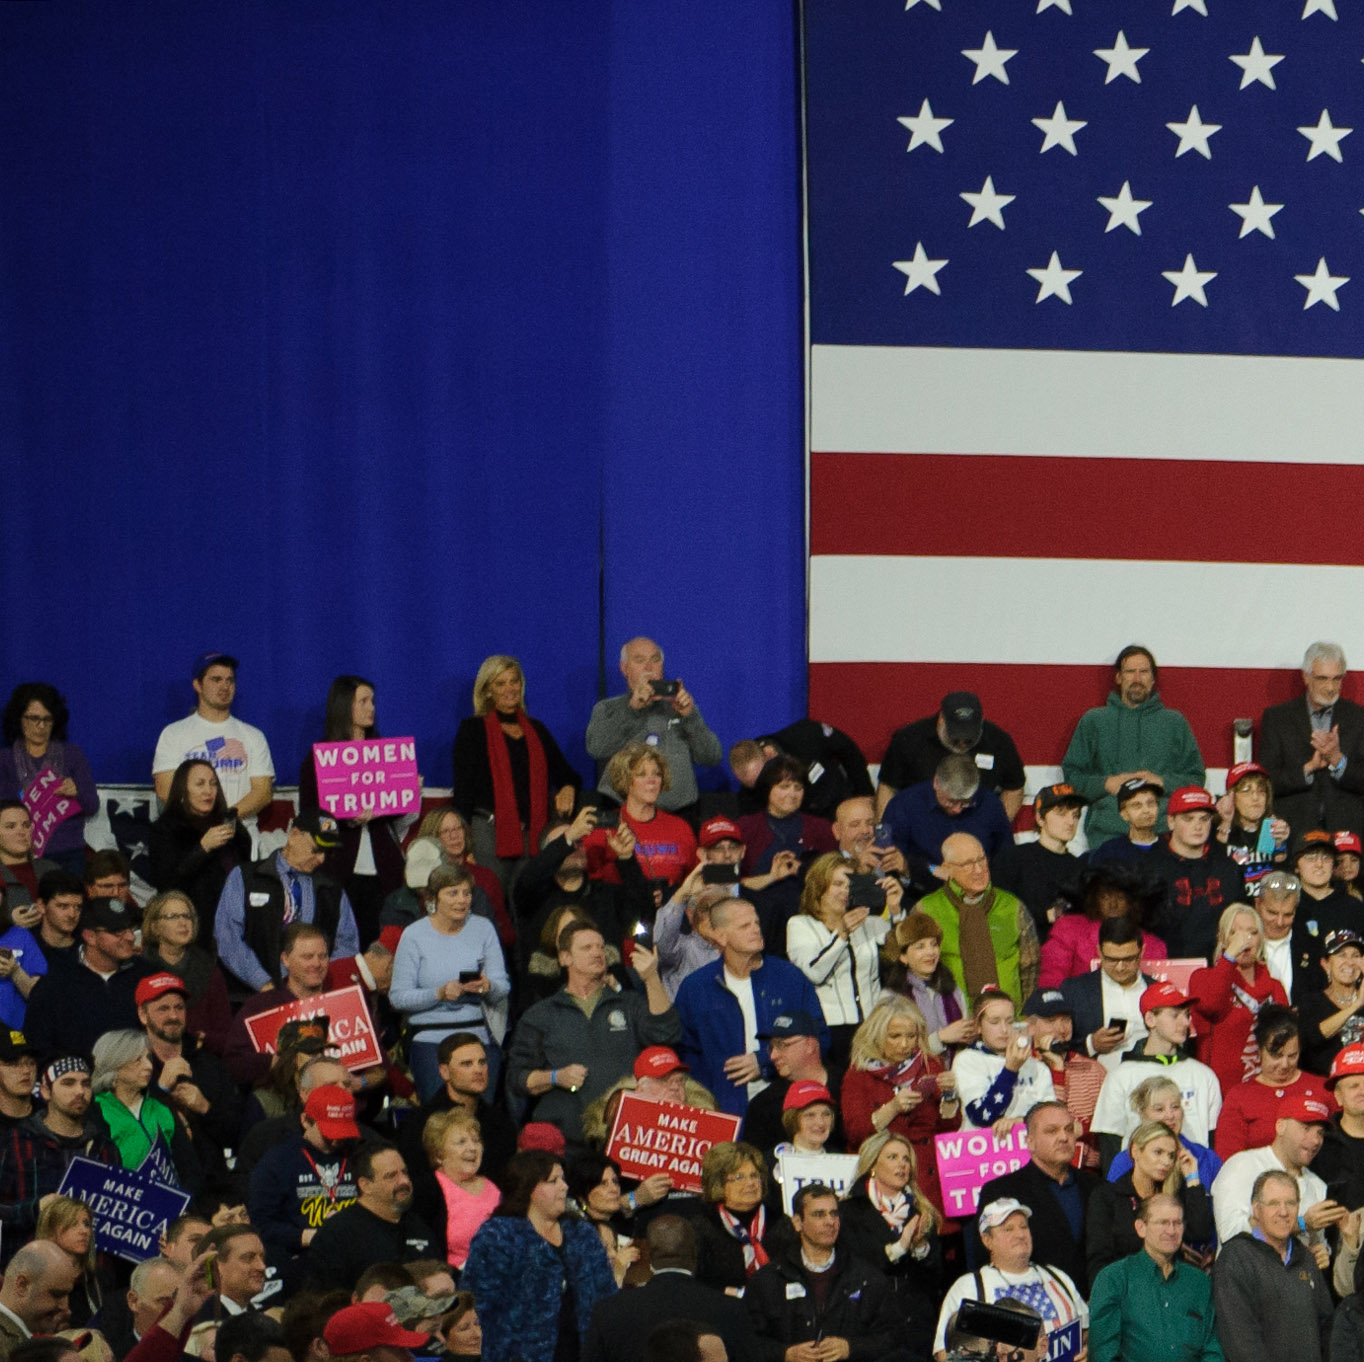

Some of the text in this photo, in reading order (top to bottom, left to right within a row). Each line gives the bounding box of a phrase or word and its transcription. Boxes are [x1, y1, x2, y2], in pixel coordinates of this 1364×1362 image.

[316, 742, 416, 768] WOMEN
[351, 771, 386, 786] FOR
[325, 789, 414, 813] TRUMP
[265, 1016, 370, 1055] AICA
[658, 1113, 698, 1133] MAKE
[614, 1123, 712, 1160] AMERIC
[938, 1130, 1028, 1160] WOME
[619, 1147, 704, 1176] GREAT AGA
[980, 1158, 1021, 1178] FOR
[103, 1179, 144, 1201] MAKE
[794, 1177, 844, 1191] TRU
[64, 1186, 169, 1239] AMERICA
[100, 1221, 152, 1250] AGAIN
